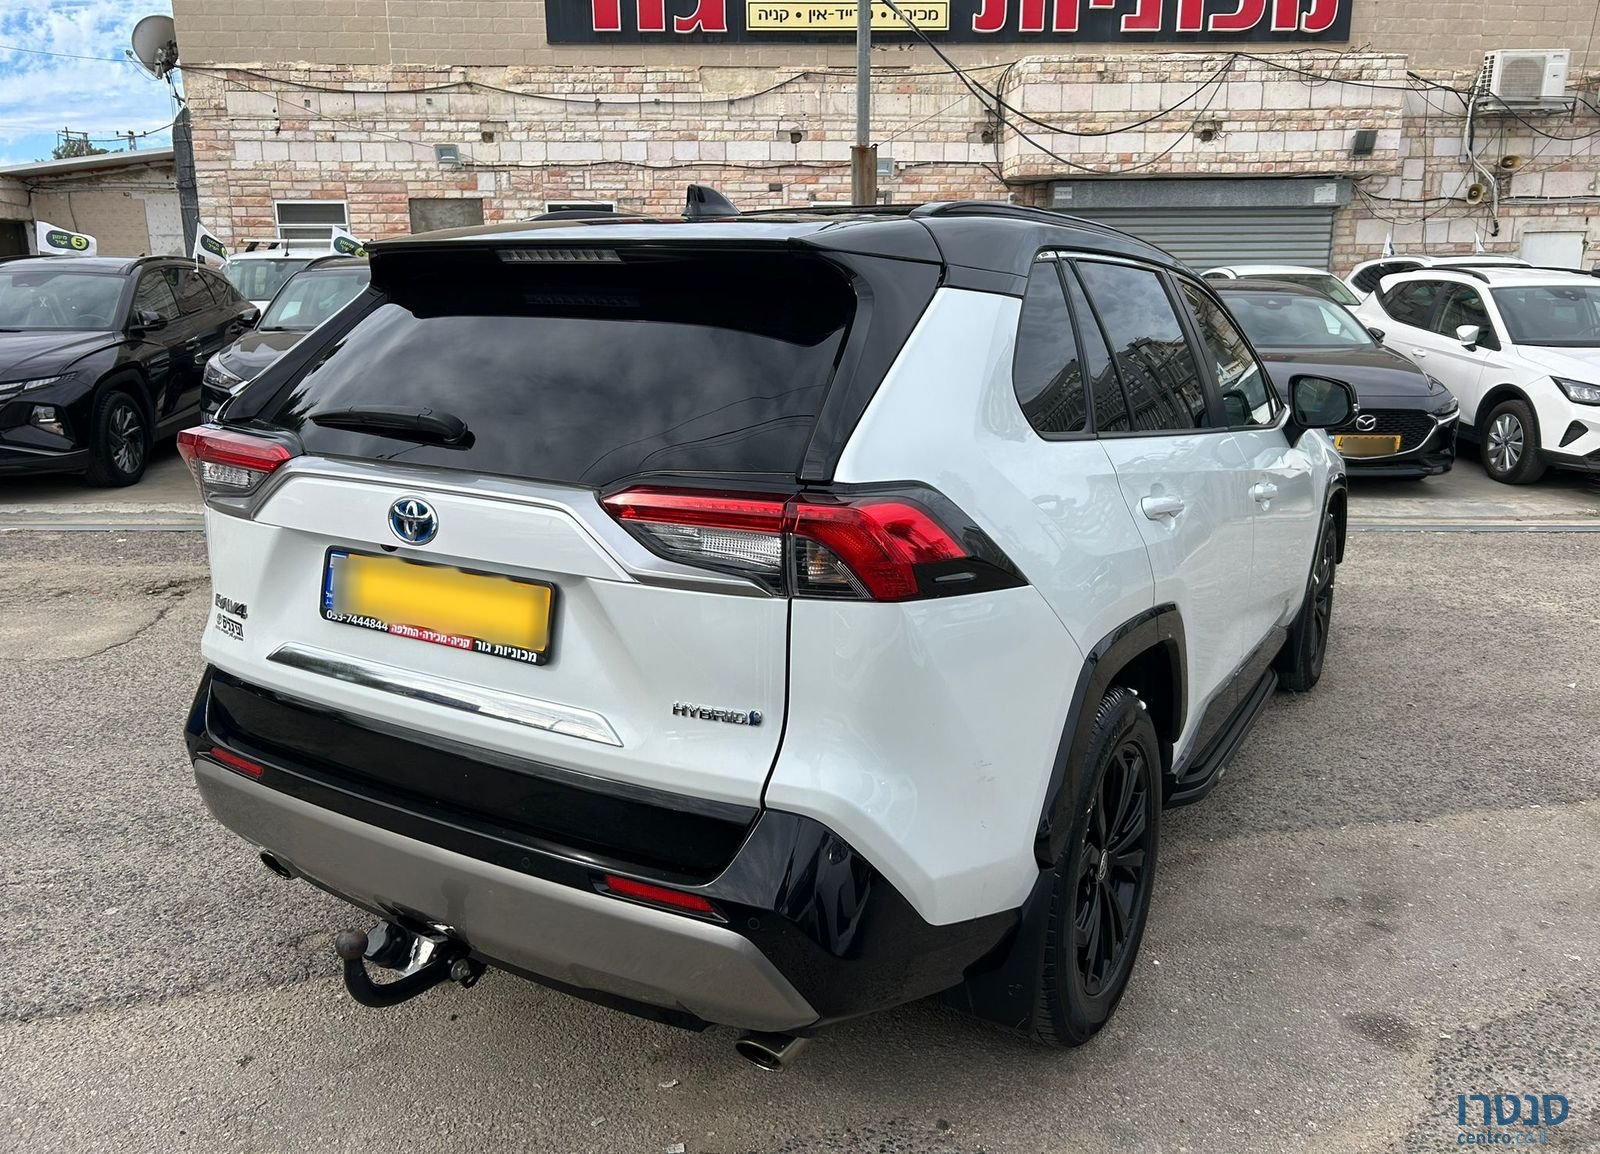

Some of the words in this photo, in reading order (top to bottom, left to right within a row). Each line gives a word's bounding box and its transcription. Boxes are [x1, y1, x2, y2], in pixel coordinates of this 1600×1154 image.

[758, 9, 790, 23] קניה
[808, 9, 873, 23] ייד-אין
[75, 238, 83, 247] 5
[391, 624, 419, 637] החלפה
[422, 630, 447, 644] מכירה
[449, 636, 471, 649] קניה
[475, 640, 492, 653] גור
[494, 644, 538, 663] מכוניות
[672, 701, 748, 725] HYBRID
